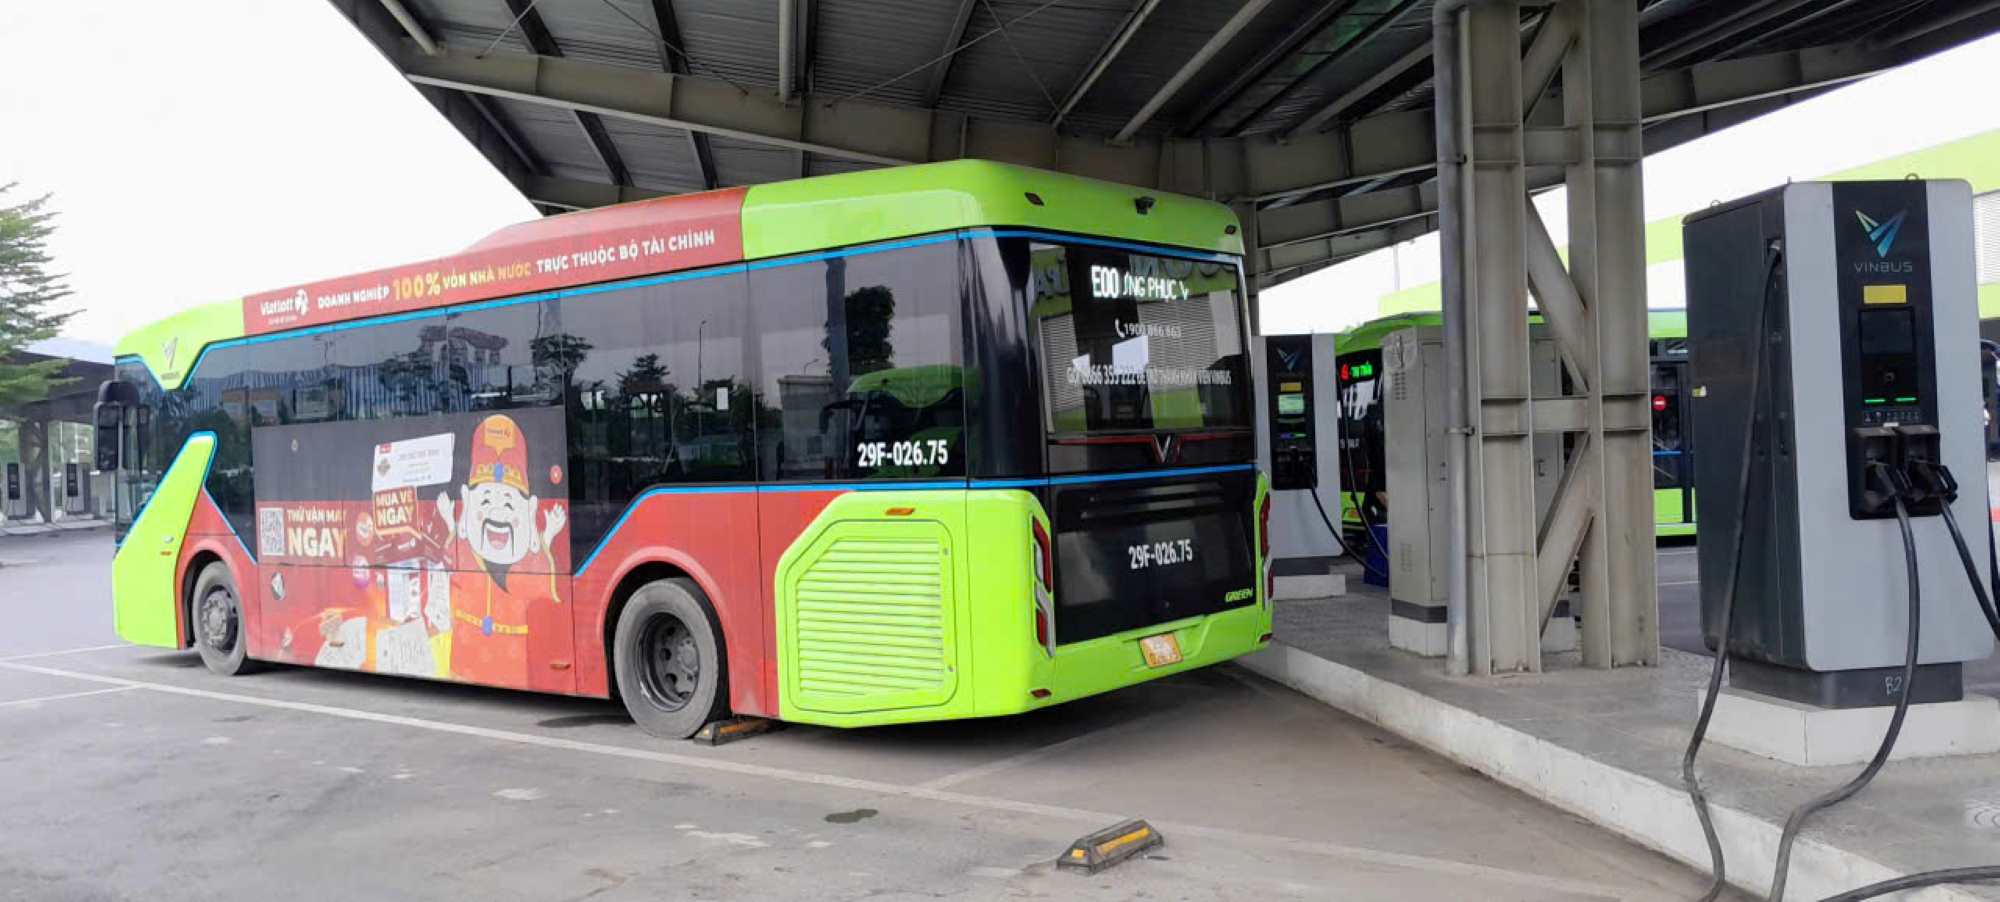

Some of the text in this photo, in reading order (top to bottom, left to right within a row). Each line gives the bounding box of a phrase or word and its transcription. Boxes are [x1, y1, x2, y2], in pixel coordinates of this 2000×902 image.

[393, 271, 441, 300] 100%
[571, 244, 616, 267] THUỘC
[619, 238, 639, 262] BỘ
[641, 235, 665, 256] TÀI
[668, 228, 716, 251] CHÍNH
[1853, 261, 1913, 273] VINBUS
[857, 439, 948, 467] 29F-026.75
[376, 504, 414, 528] NGAY
[287, 527, 347, 558] NGAY
[1128, 539, 1193, 570] 29F-026.75
